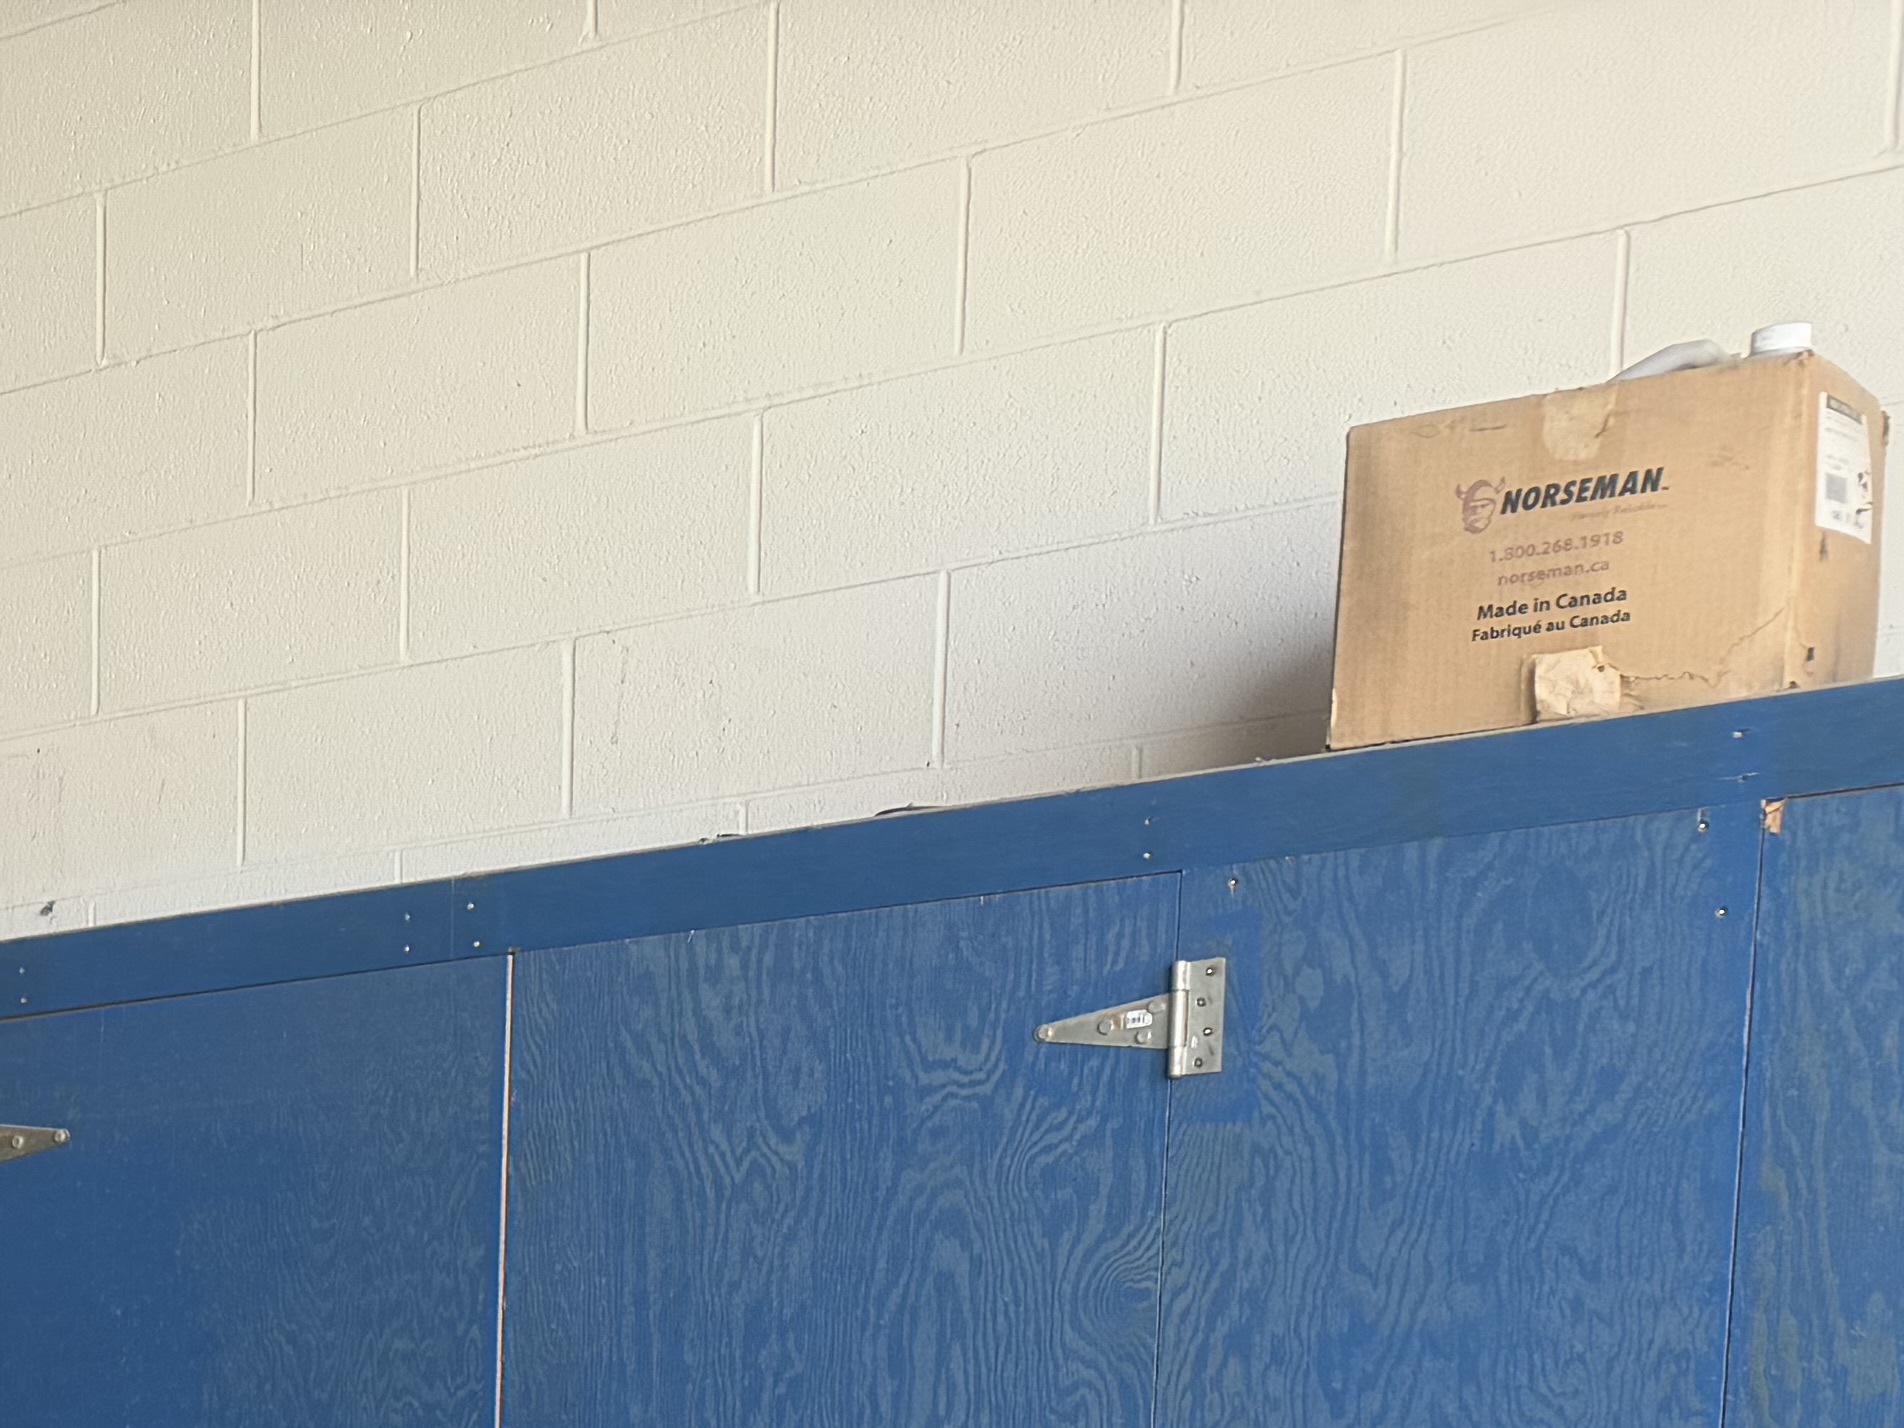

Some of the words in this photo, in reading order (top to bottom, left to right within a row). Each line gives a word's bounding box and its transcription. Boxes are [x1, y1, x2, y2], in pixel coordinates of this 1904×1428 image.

[1499, 466, 1664, 516] NORSEMAN
[1489, 530, 1624, 563] 1.800.268.1918
[1497, 559, 1611, 587] norseman.ca
[1476, 599, 1530, 621] Made
[1533, 597, 1552, 613] in
[1555, 586, 1628, 610] Canada
[1471, 619, 1542, 642] Fabriqué
[1545, 619, 1566, 633] au
[1569, 609, 1631, 628] Canada
